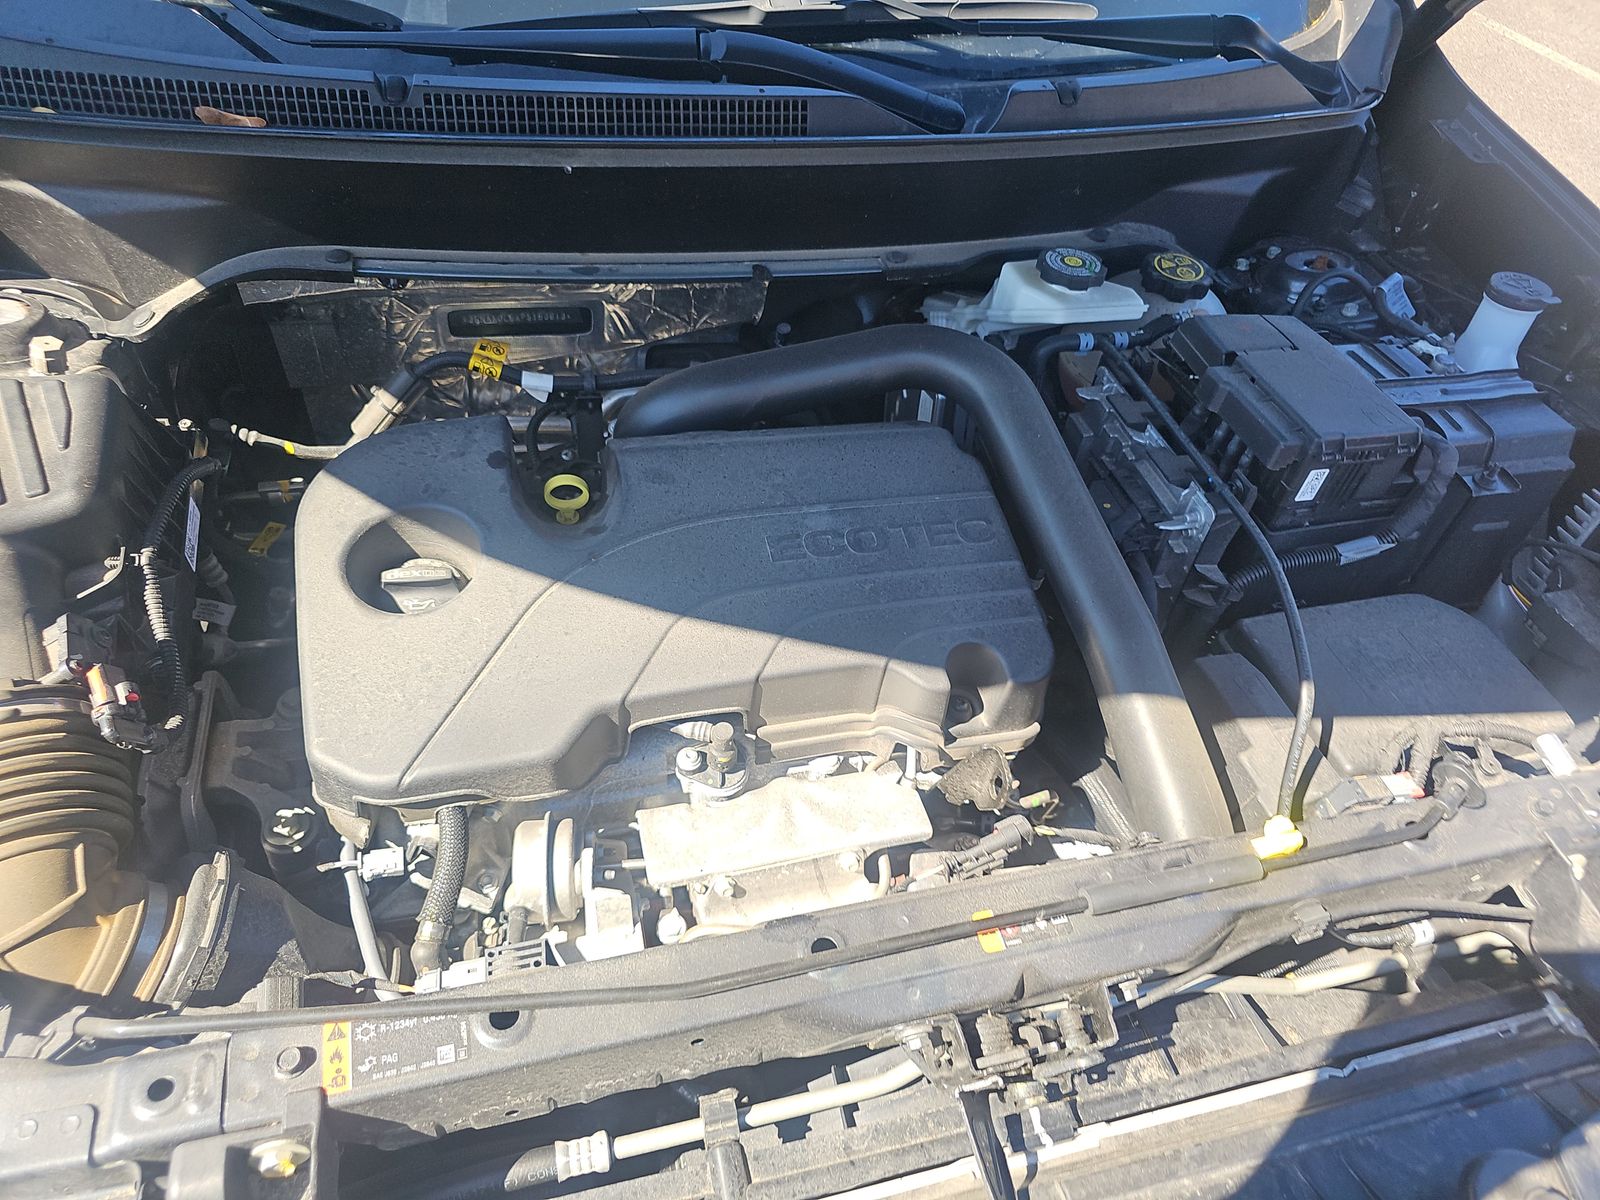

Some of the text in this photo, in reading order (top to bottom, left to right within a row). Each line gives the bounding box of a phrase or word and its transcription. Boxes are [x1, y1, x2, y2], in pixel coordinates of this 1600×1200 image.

[765, 519, 996, 562] ECOTEC
[385, 568, 447, 580] dexos
[381, 1052, 399, 1065] PAG
